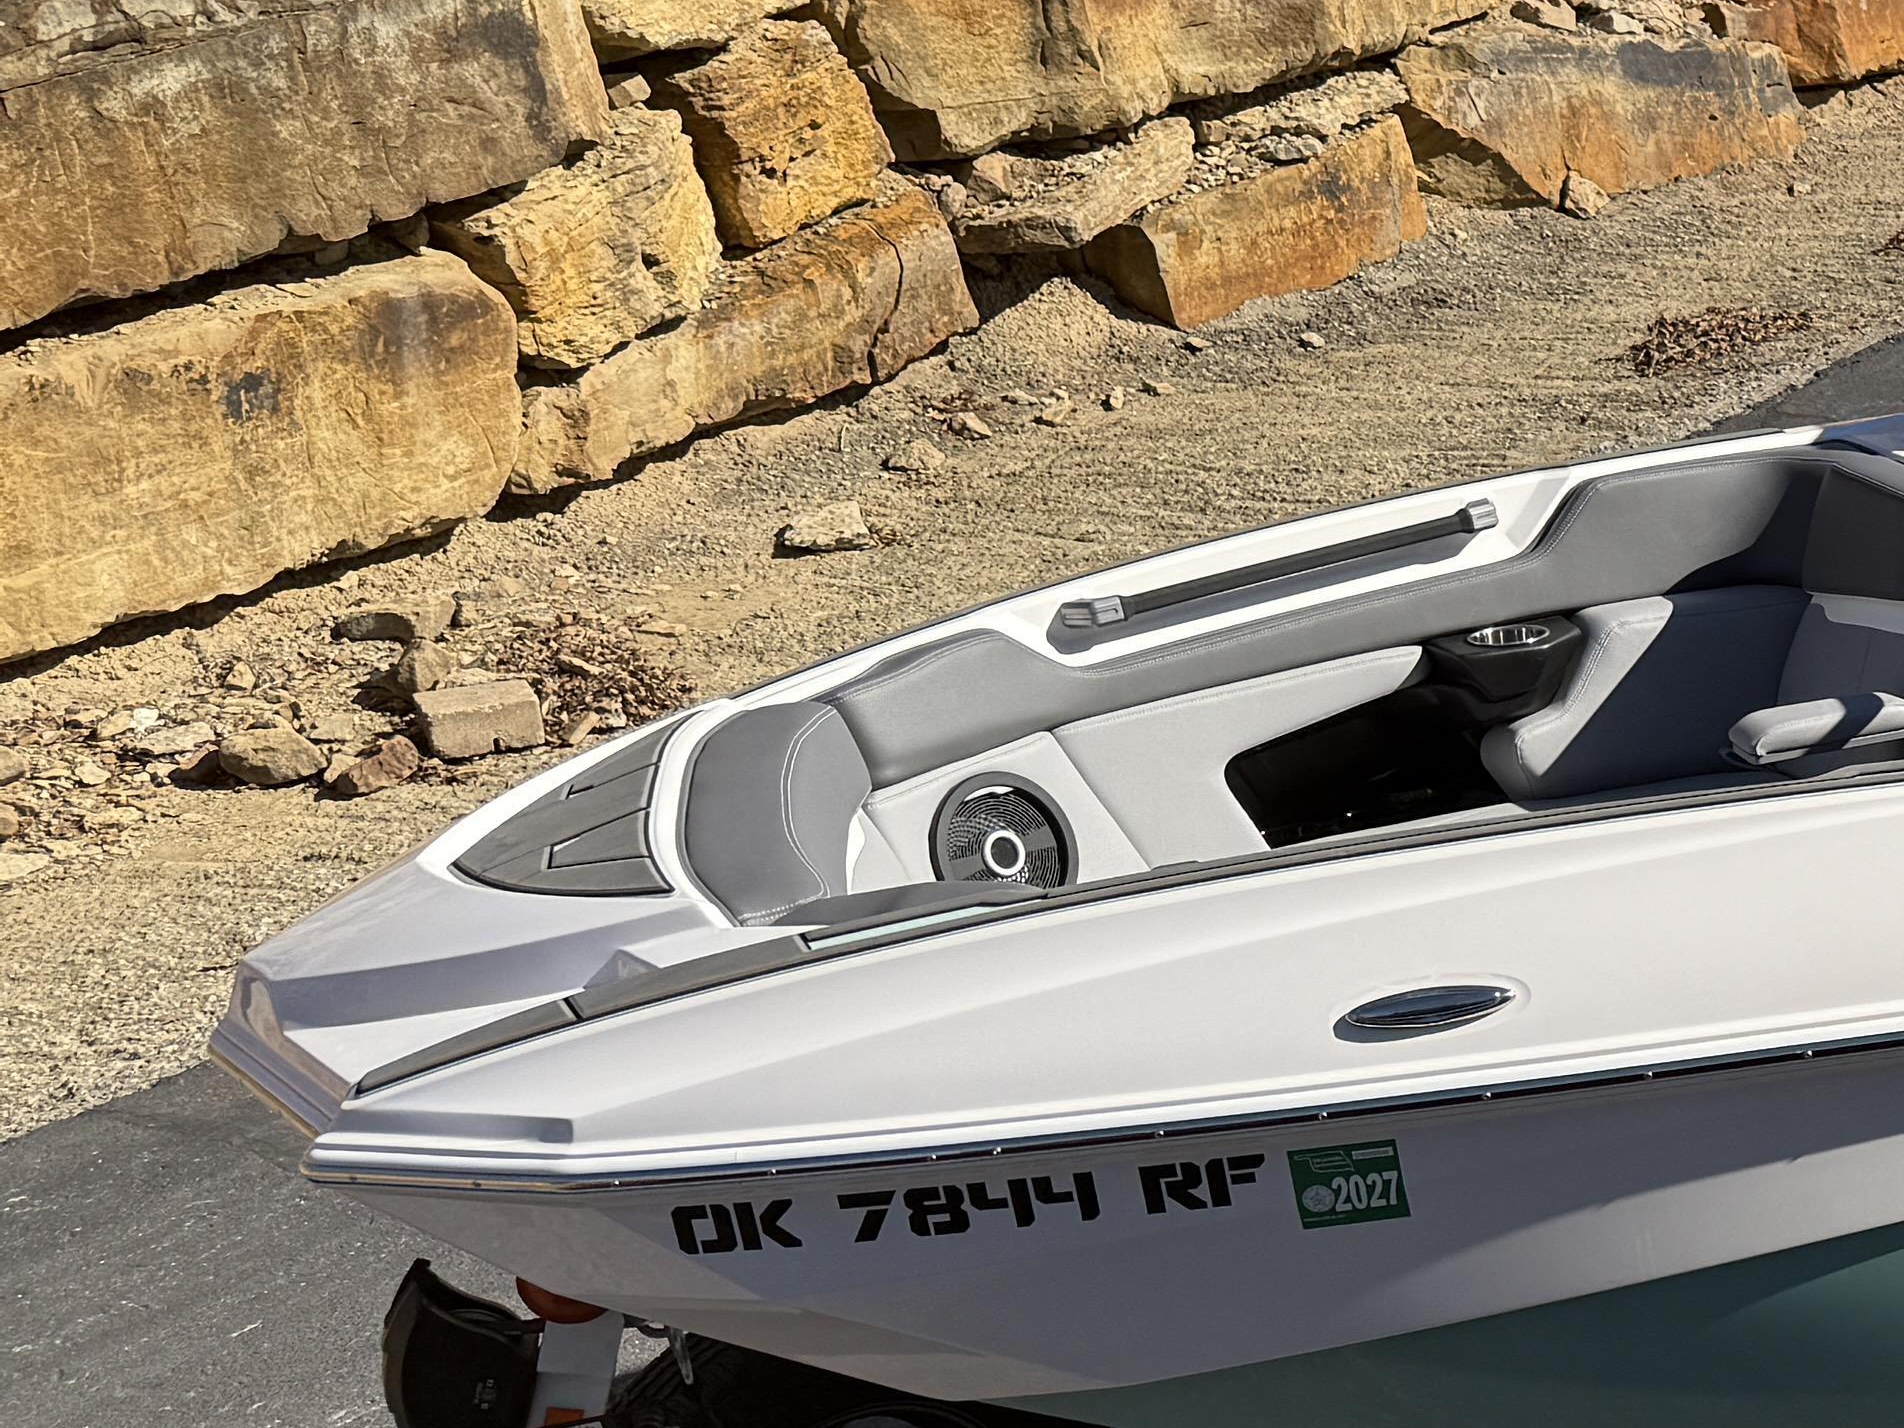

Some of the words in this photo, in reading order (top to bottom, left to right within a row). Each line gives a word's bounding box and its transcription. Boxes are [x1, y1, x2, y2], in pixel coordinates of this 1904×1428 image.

[671, 1199, 802, 1255] OK
[838, 1172, 1100, 1243] 7844
[1138, 1154, 1266, 1215] RF
[1331, 1170, 1399, 1212] 2027
